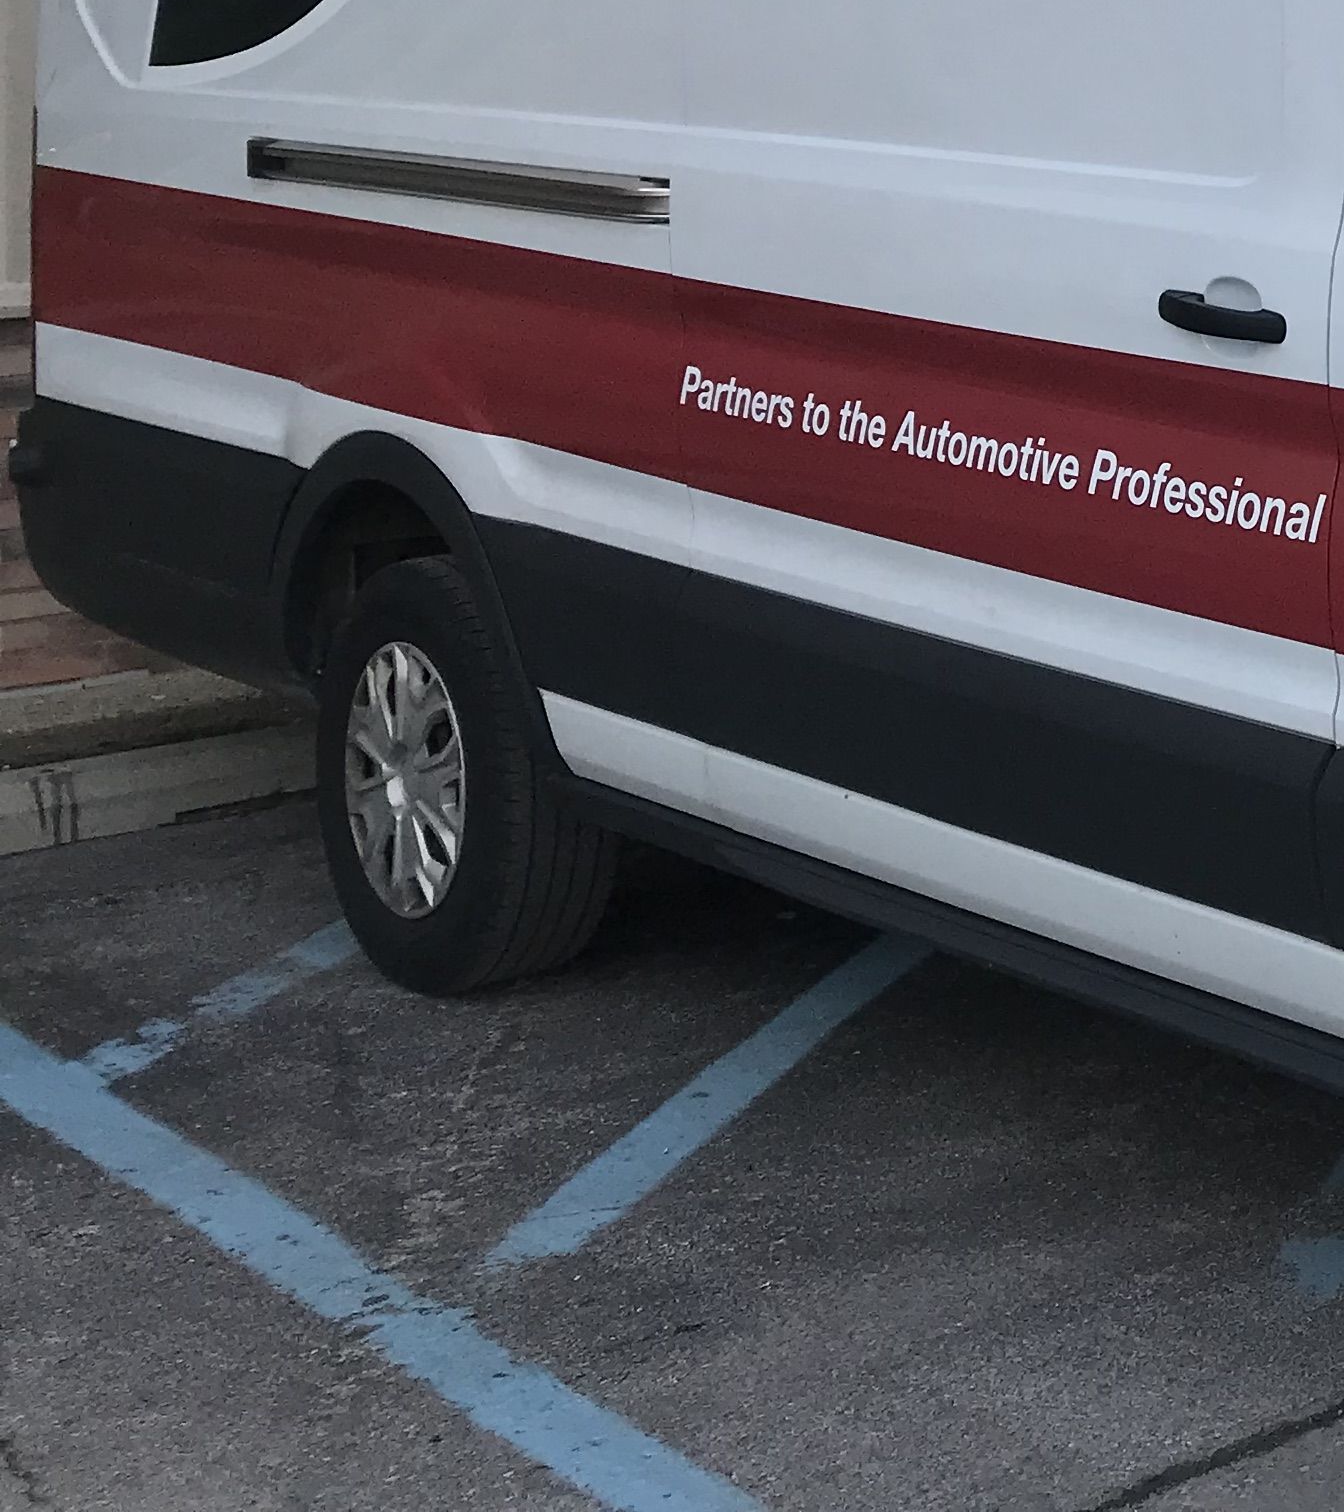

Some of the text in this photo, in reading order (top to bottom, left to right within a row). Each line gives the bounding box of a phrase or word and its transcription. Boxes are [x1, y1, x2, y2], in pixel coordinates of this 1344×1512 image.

[679, 364, 1329, 544] Partners to the Automotive Professional
